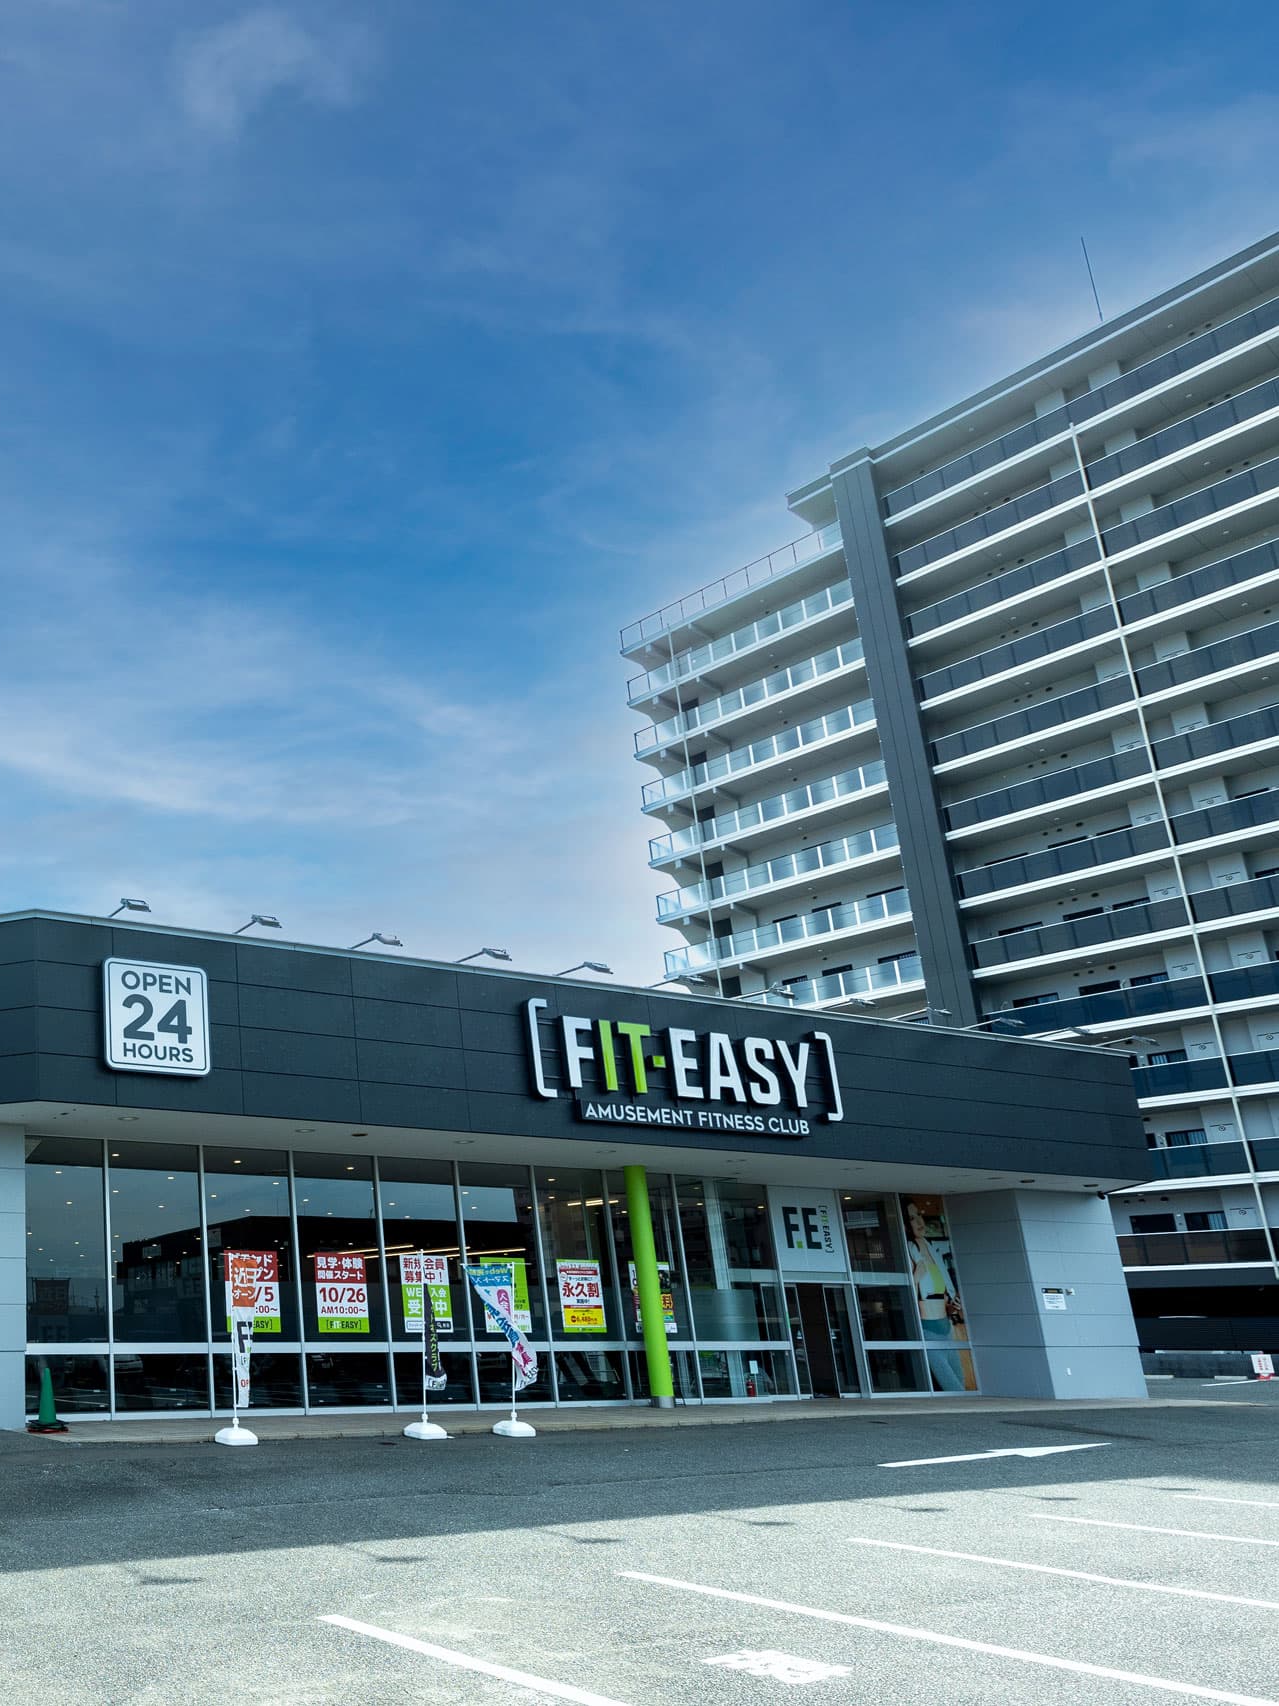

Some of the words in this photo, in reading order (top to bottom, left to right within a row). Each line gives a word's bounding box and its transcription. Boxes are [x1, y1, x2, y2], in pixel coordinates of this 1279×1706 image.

[121, 970, 191, 996] OPEN
[122, 994, 192, 1044] 24
[123, 1042, 193, 1063] HOURS
[584, 1102, 694, 1128] AMUSEMENT
[698, 1112, 765, 1133] FITNESS
[768, 1118, 810, 1135] CLUB
[319, 1287, 366, 1304] 10/26
[562, 1281, 600, 1298] 永久割
